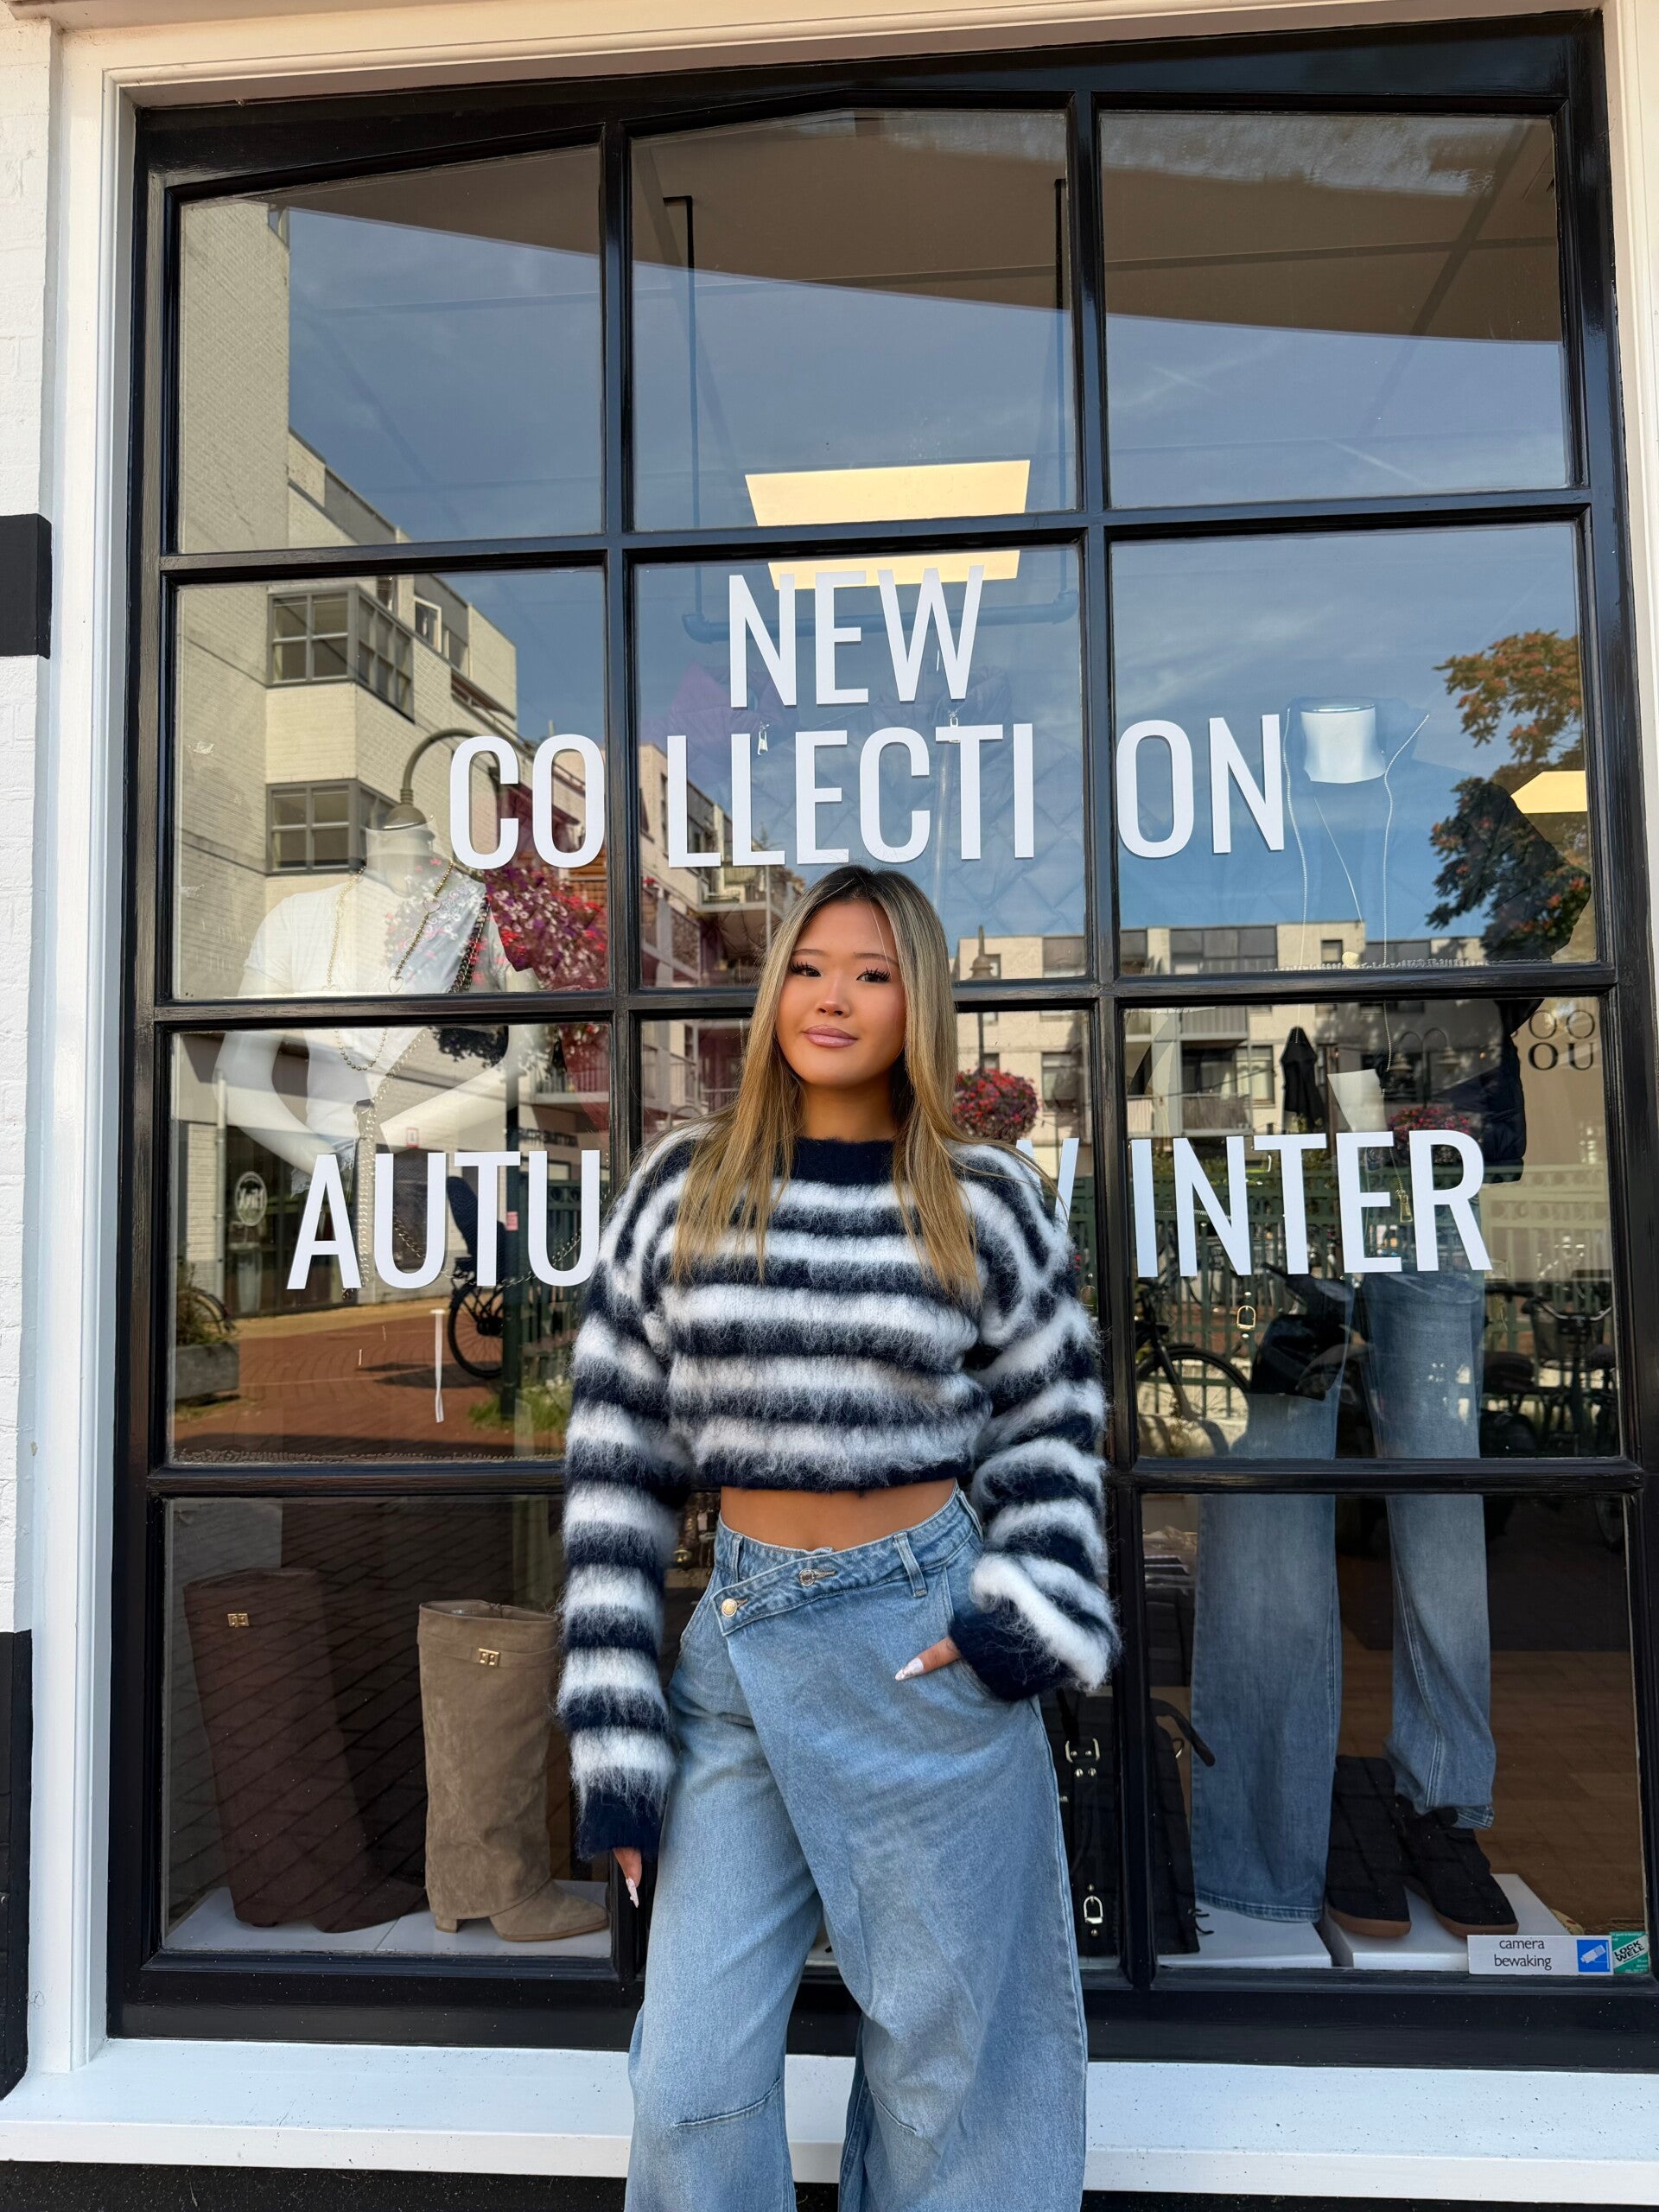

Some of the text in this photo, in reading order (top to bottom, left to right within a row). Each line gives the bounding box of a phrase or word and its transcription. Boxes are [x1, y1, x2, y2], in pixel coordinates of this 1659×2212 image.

[729, 564, 985, 708] NEW
[1514, 1009, 1595, 1039] OO
[287, 1150, 600, 1290] AUTU
[1499, 1940, 1545, 1949] camera
[1614, 1940, 1642, 1957] LOCK
[1616, 1945, 1645, 1962] WELL
[1494, 1955, 1553, 1970] bewaking
